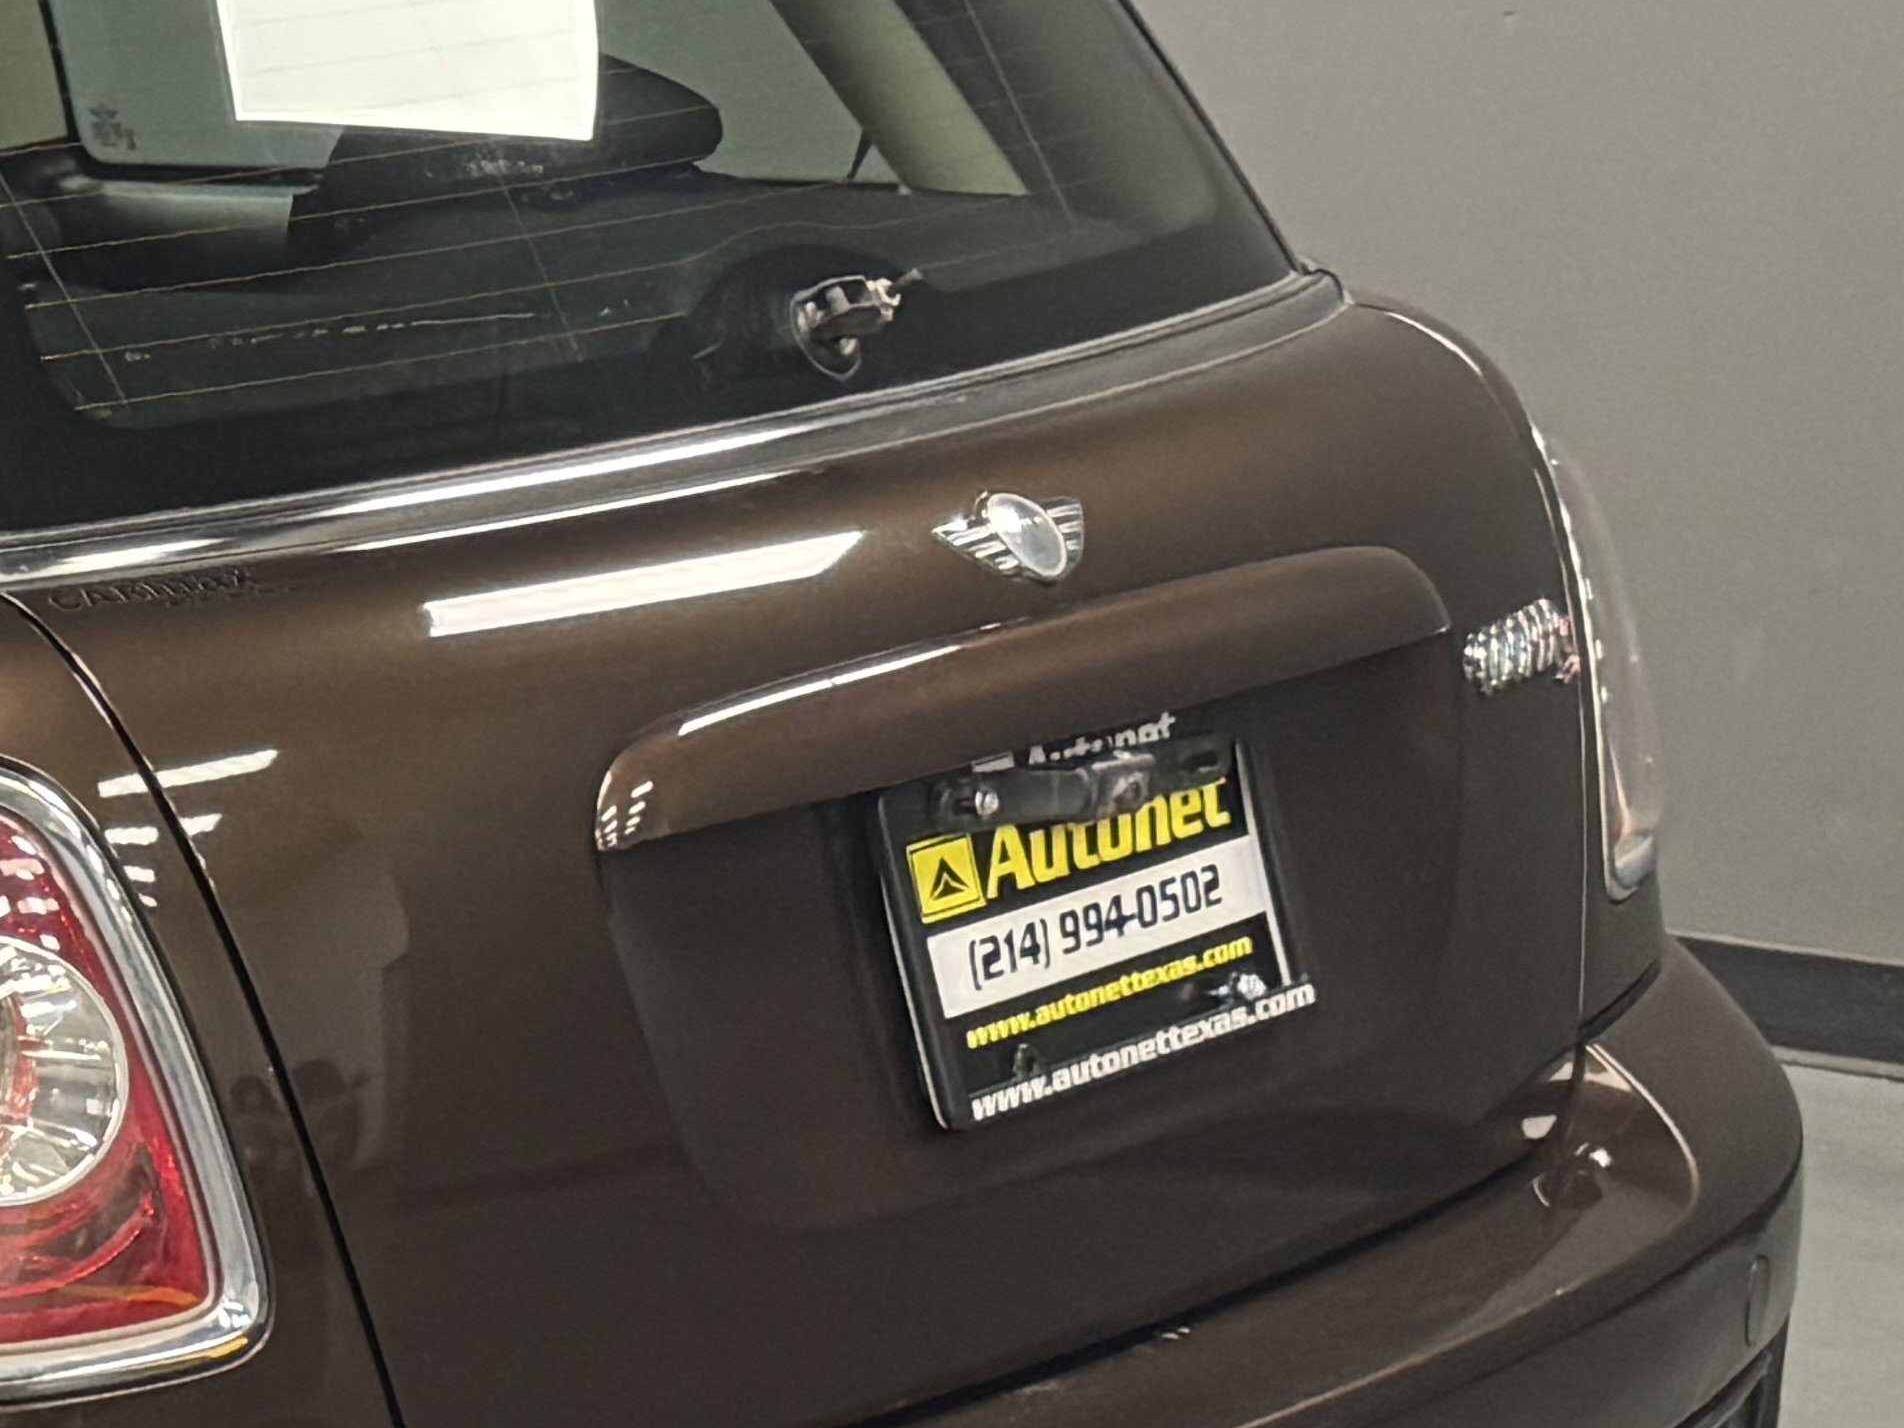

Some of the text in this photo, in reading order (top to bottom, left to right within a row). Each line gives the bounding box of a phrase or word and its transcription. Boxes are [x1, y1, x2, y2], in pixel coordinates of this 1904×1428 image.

[985, 776, 1232, 900] Autonet
[968, 863, 1223, 990] (214) 994-0502
[966, 936, 1254, 1050] www.autonettexas.com
[971, 982, 1317, 1121] www.autonettexas.com
